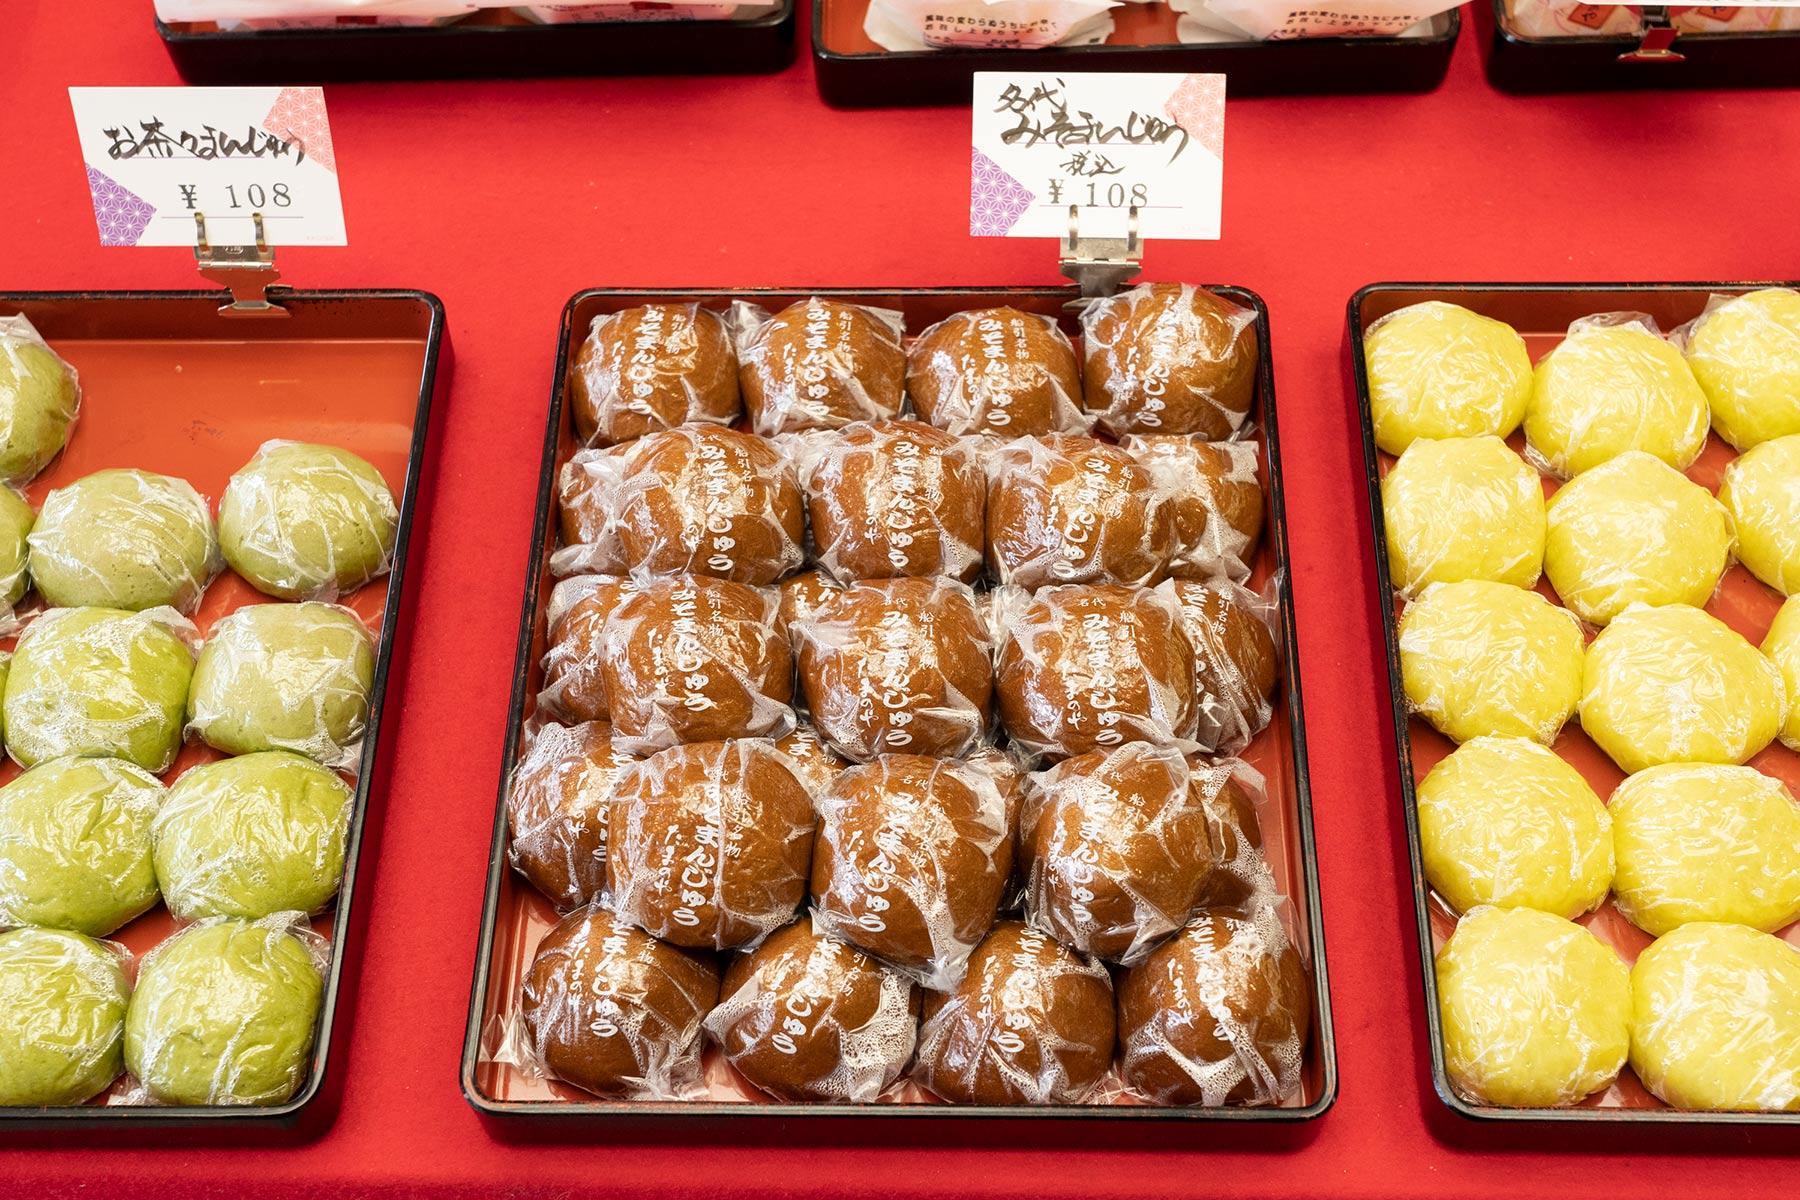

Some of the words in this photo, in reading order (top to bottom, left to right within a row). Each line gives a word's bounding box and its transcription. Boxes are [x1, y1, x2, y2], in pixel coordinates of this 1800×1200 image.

[178, 184, 198, 209] ¥
[225, 182, 292, 209] 108
[1000, 110, 1189, 168] みそまんじゅう
[1048, 178, 1064, 204] ¥
[1086, 183, 1148, 208] 108
[1059, 149, 1126, 177] 税込
[978, 318, 1014, 426] みそまんじゅう
[700, 445, 735, 571] みそまんじゅう
[735, 447, 754, 498] 船引名物
[887, 441, 920, 569] みそまんじゅう
[1053, 457, 1112, 579] みそまんじゅう
[670, 589, 718, 712] みそまんじゅう
[704, 588, 725, 638] 船引名物
[881, 610, 914, 746] みそまんじゅう
[1083, 613, 1124, 745] みそまんじゅう
[858, 791, 920, 932] みそまんじゅう
